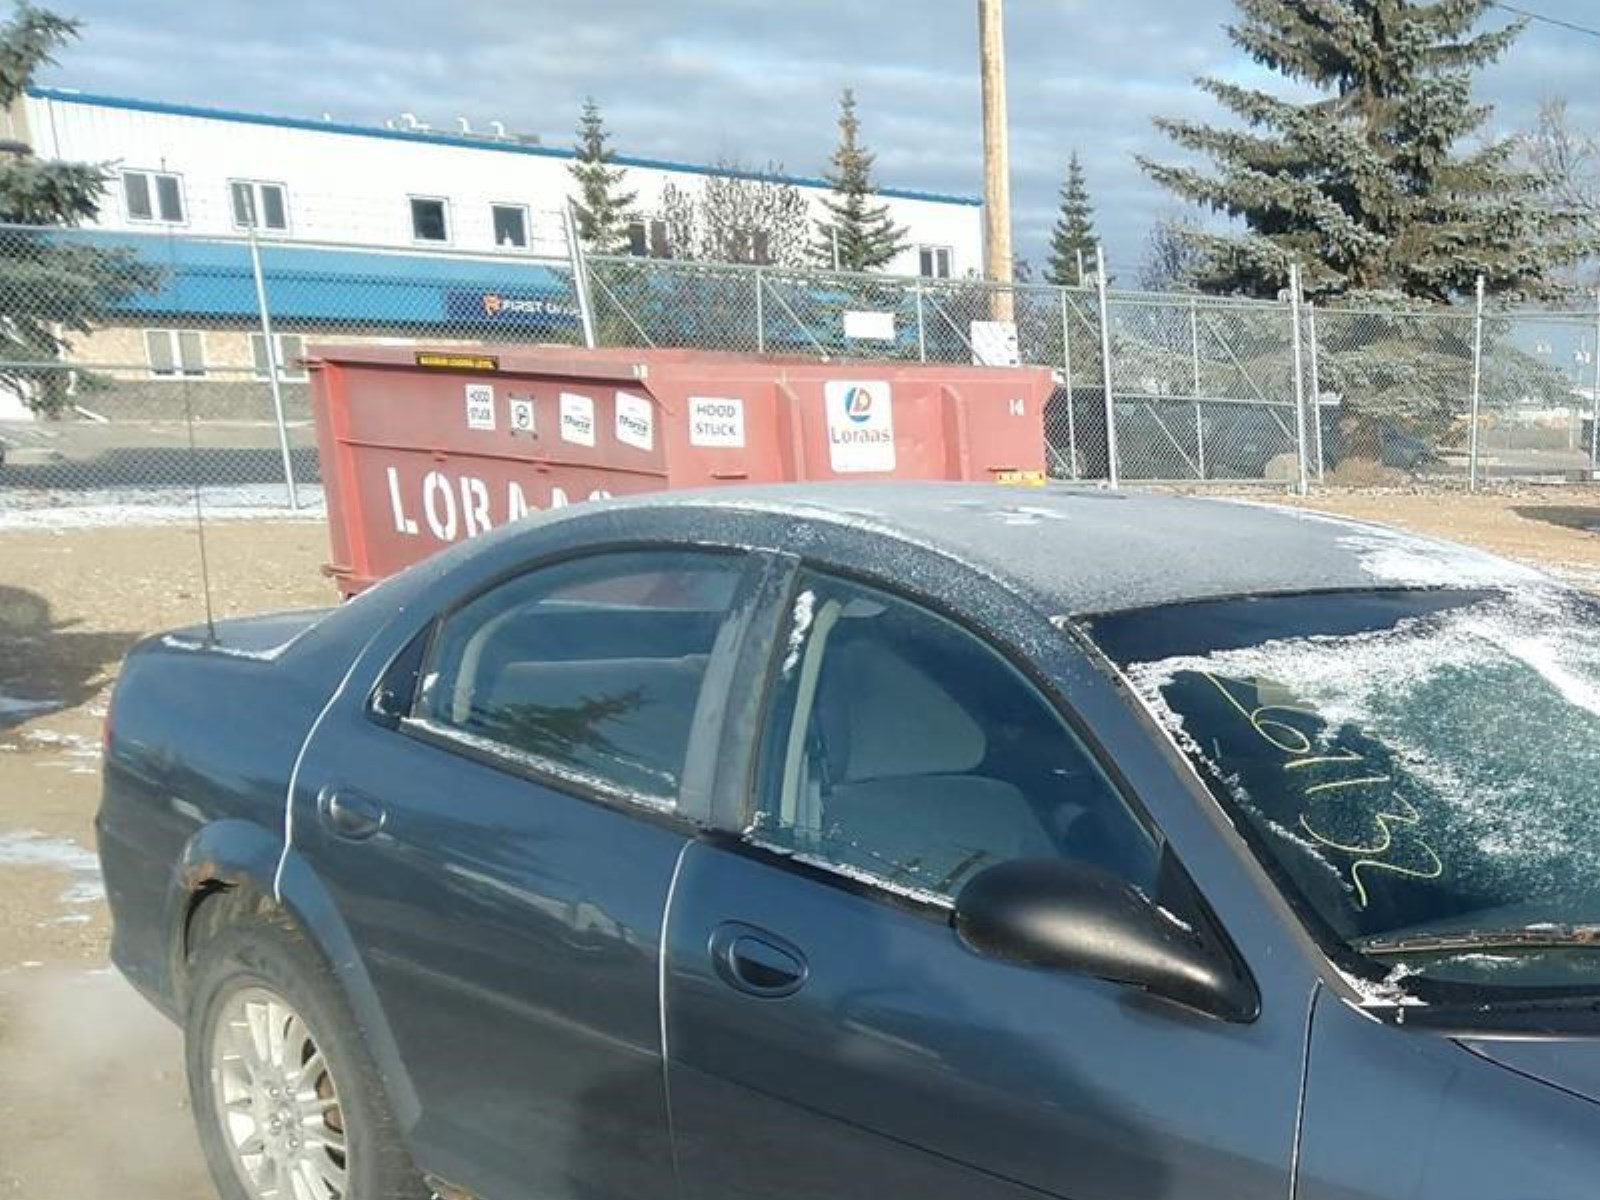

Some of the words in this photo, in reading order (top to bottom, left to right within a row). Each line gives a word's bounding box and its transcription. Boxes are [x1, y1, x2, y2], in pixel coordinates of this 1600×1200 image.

[696, 404, 737, 419] HOOD
[695, 422, 737, 437] STUCK
[830, 426, 892, 444] Loraas
